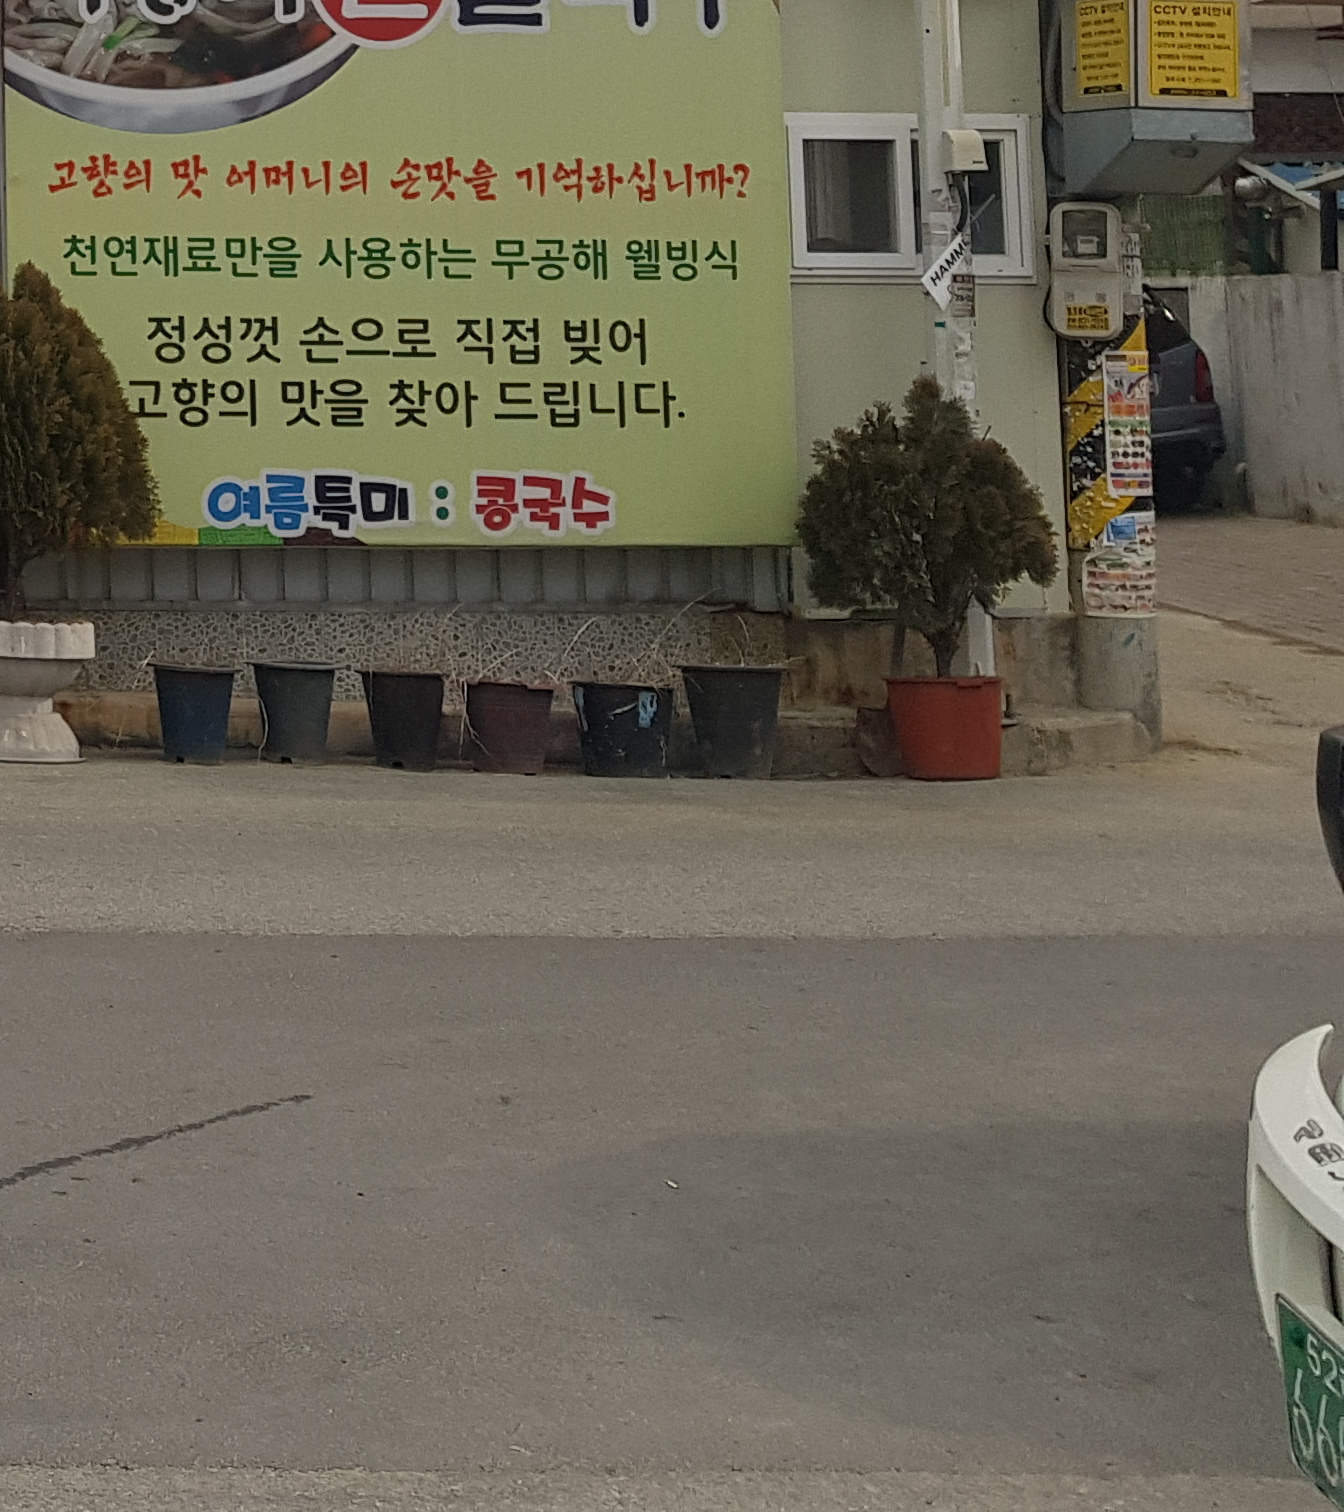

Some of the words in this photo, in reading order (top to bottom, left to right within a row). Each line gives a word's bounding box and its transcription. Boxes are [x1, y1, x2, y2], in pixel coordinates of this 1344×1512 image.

[1153, 5, 1187, 14] CCTV
[46, 153, 154, 198] 고향의
[170, 154, 207, 199] 맛
[225, 158, 370, 199] 어머니의
[389, 156, 498, 203] 손맛을
[515, 156, 752, 204] 기억하십니까?
[62, 235, 302, 279] 천연재료만을
[317, 237, 478, 280] 사용하는
[489, 239, 610, 281] 무공해
[624, 239, 740, 282] 웰빙식
[145, 316, 281, 366] 정성껏
[297, 316, 438, 364] 손으로
[455, 317, 542, 366] 직접
[563, 318, 648, 366] 빚어
[127, 378, 258, 429] 고향의
[279, 378, 369, 429] 맛을
[386, 378, 480, 429] 찾아
[493, 379, 687, 430] 드립니다.
[205, 474, 410, 534] 여름특미
[473, 473, 613, 532] 콩국수
